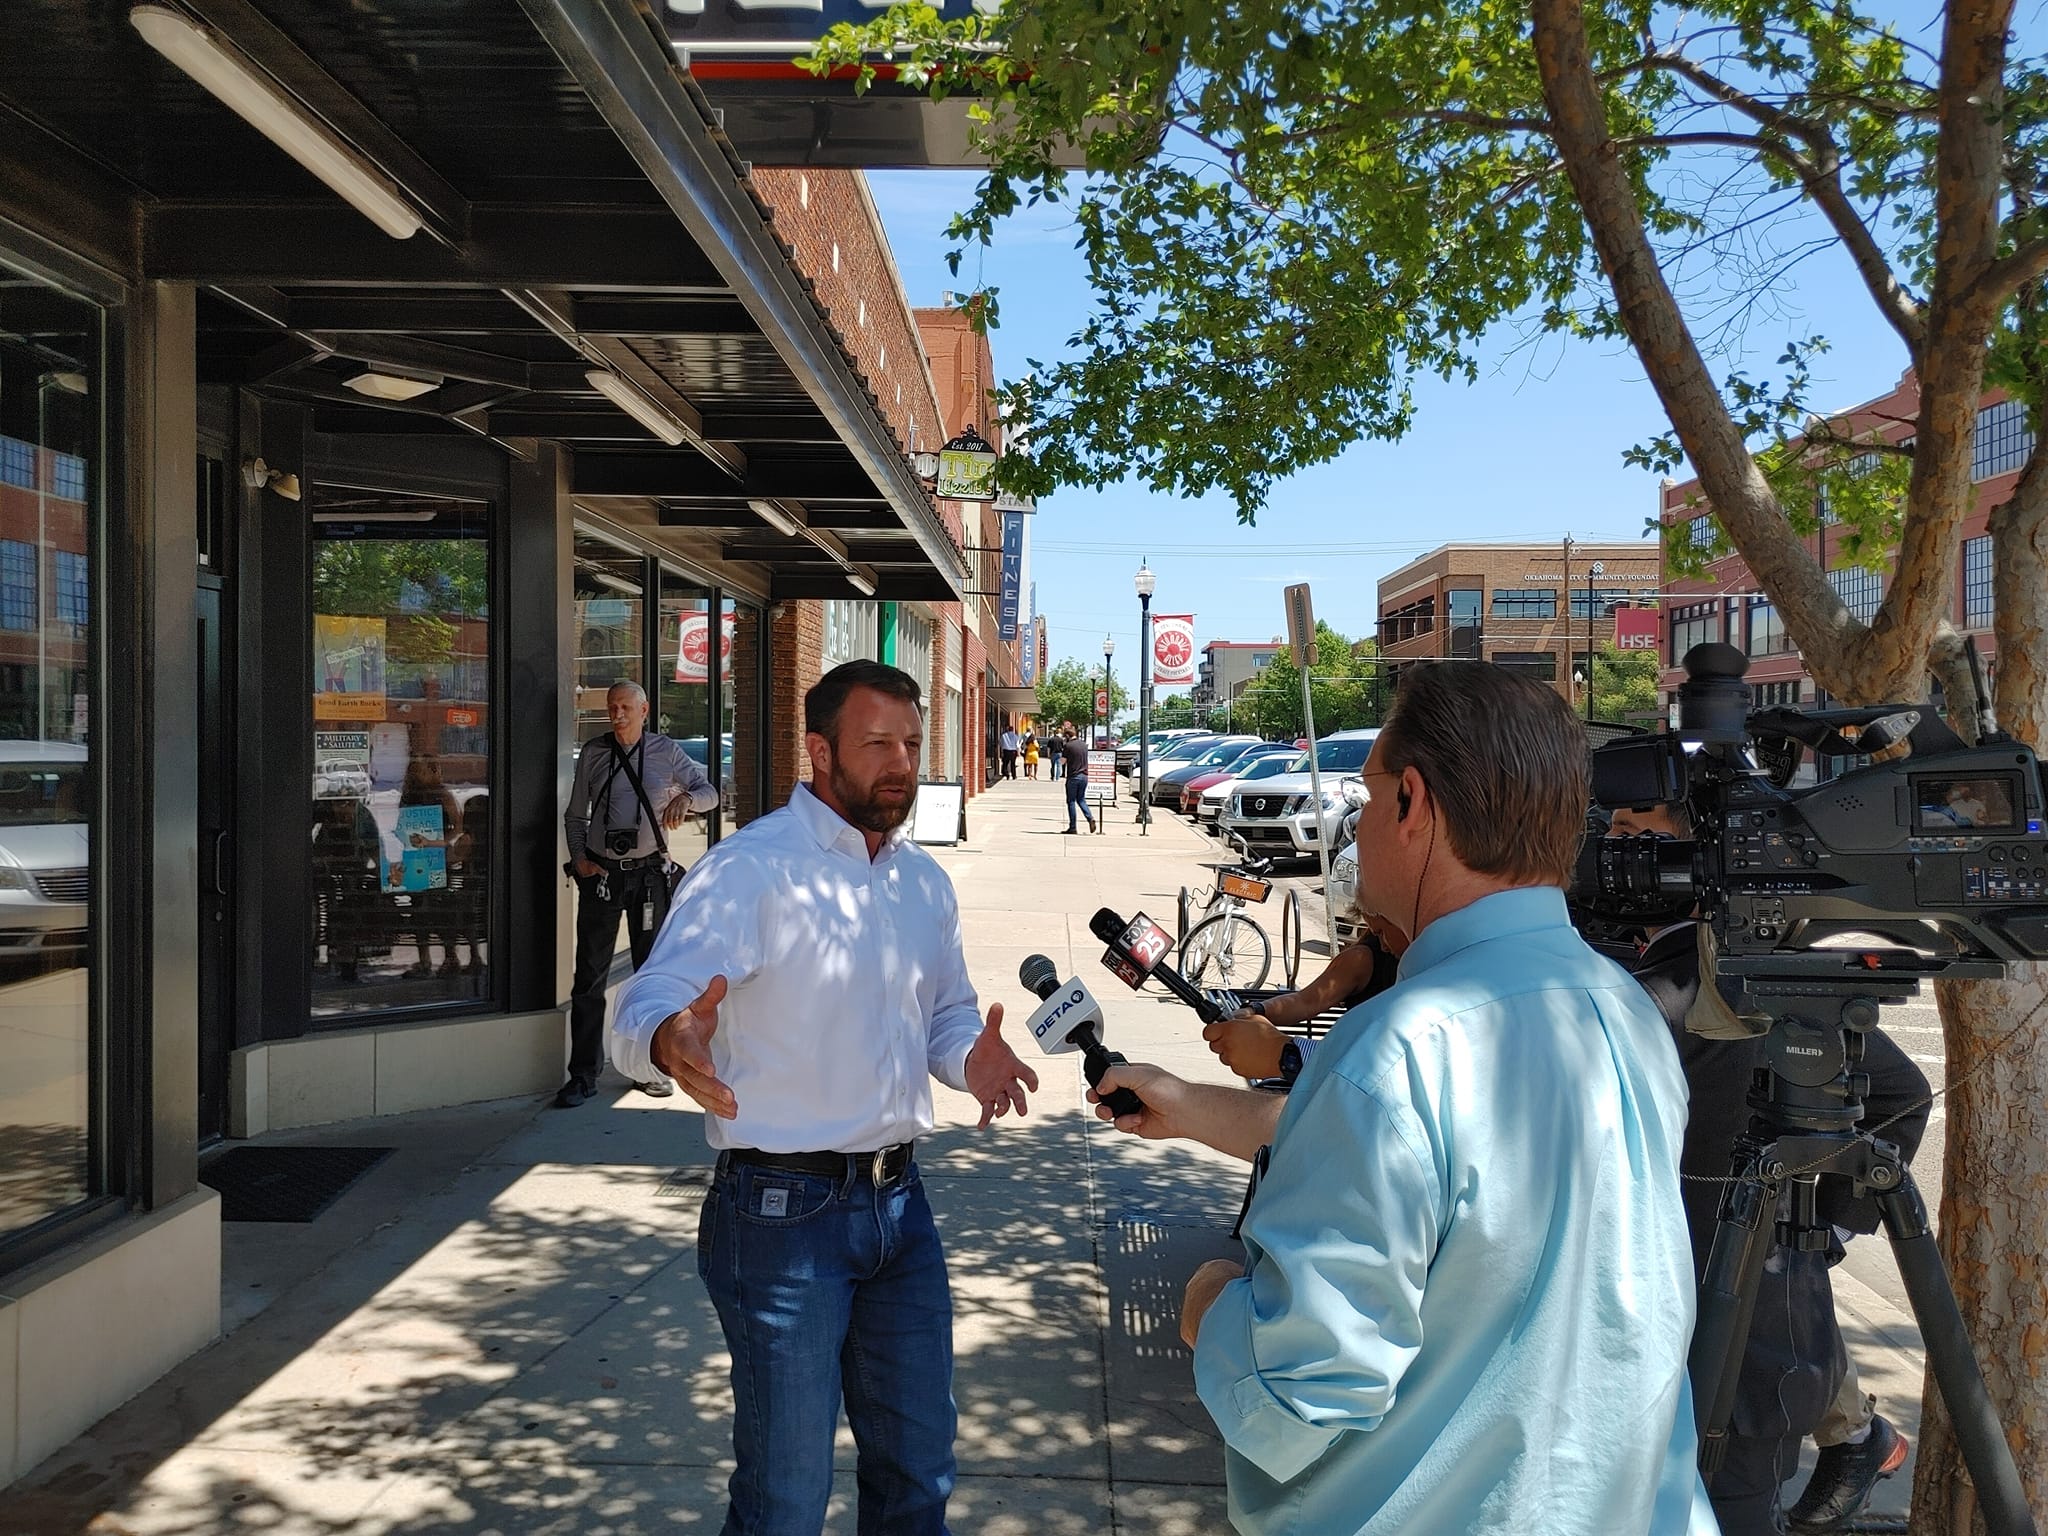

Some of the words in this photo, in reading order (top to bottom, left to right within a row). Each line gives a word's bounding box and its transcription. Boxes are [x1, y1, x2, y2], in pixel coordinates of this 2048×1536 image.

[951, 440, 965, 449] Est.
[966, 442, 985, 451] 2017
[1002, 520, 1021, 635] FITNESS
[1620, 634, 1656, 649] HSE
[1121, 919, 1149, 948] FOX
[1136, 931, 1166, 964] 25
[1035, 1001, 1074, 1038] OETA
[1786, 1045, 1818, 1056] MILLER
